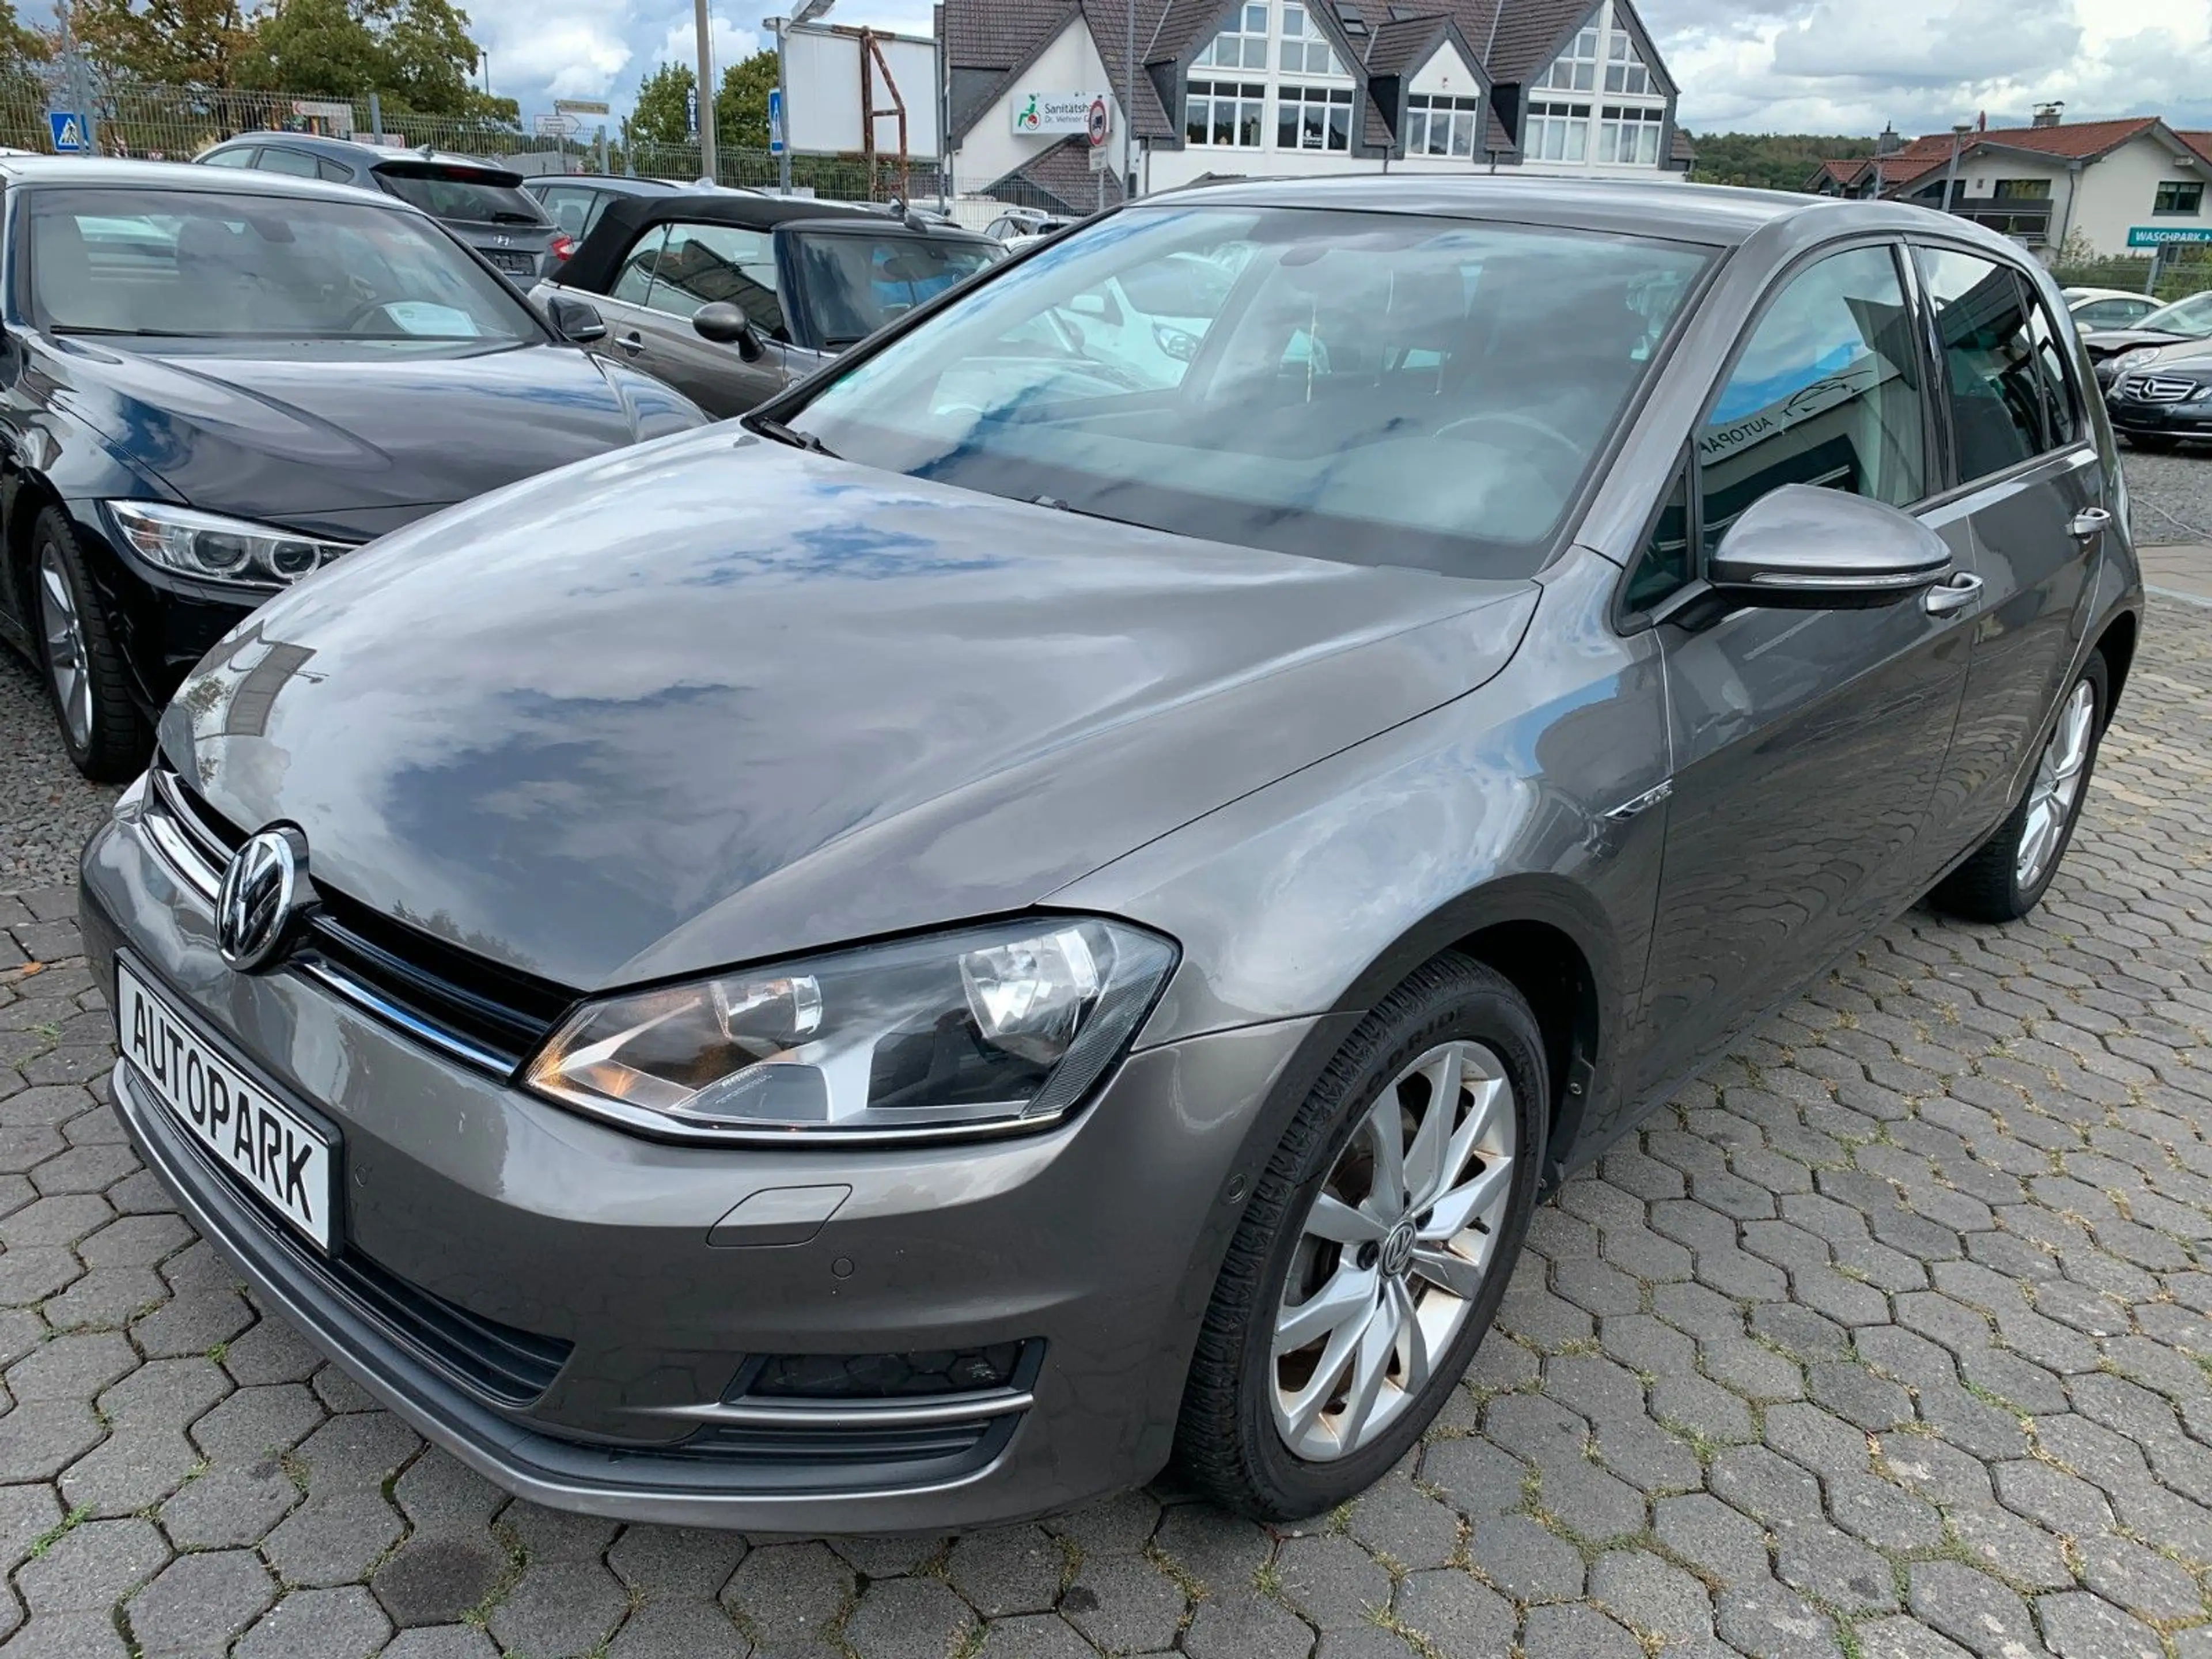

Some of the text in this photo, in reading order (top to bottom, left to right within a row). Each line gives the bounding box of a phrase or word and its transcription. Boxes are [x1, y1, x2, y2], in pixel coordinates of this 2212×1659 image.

[687, 88, 697, 131] HOTEL
[2135, 230, 2201, 241] WASCHPARK
[133, 990, 313, 1222] AUTOPARK
